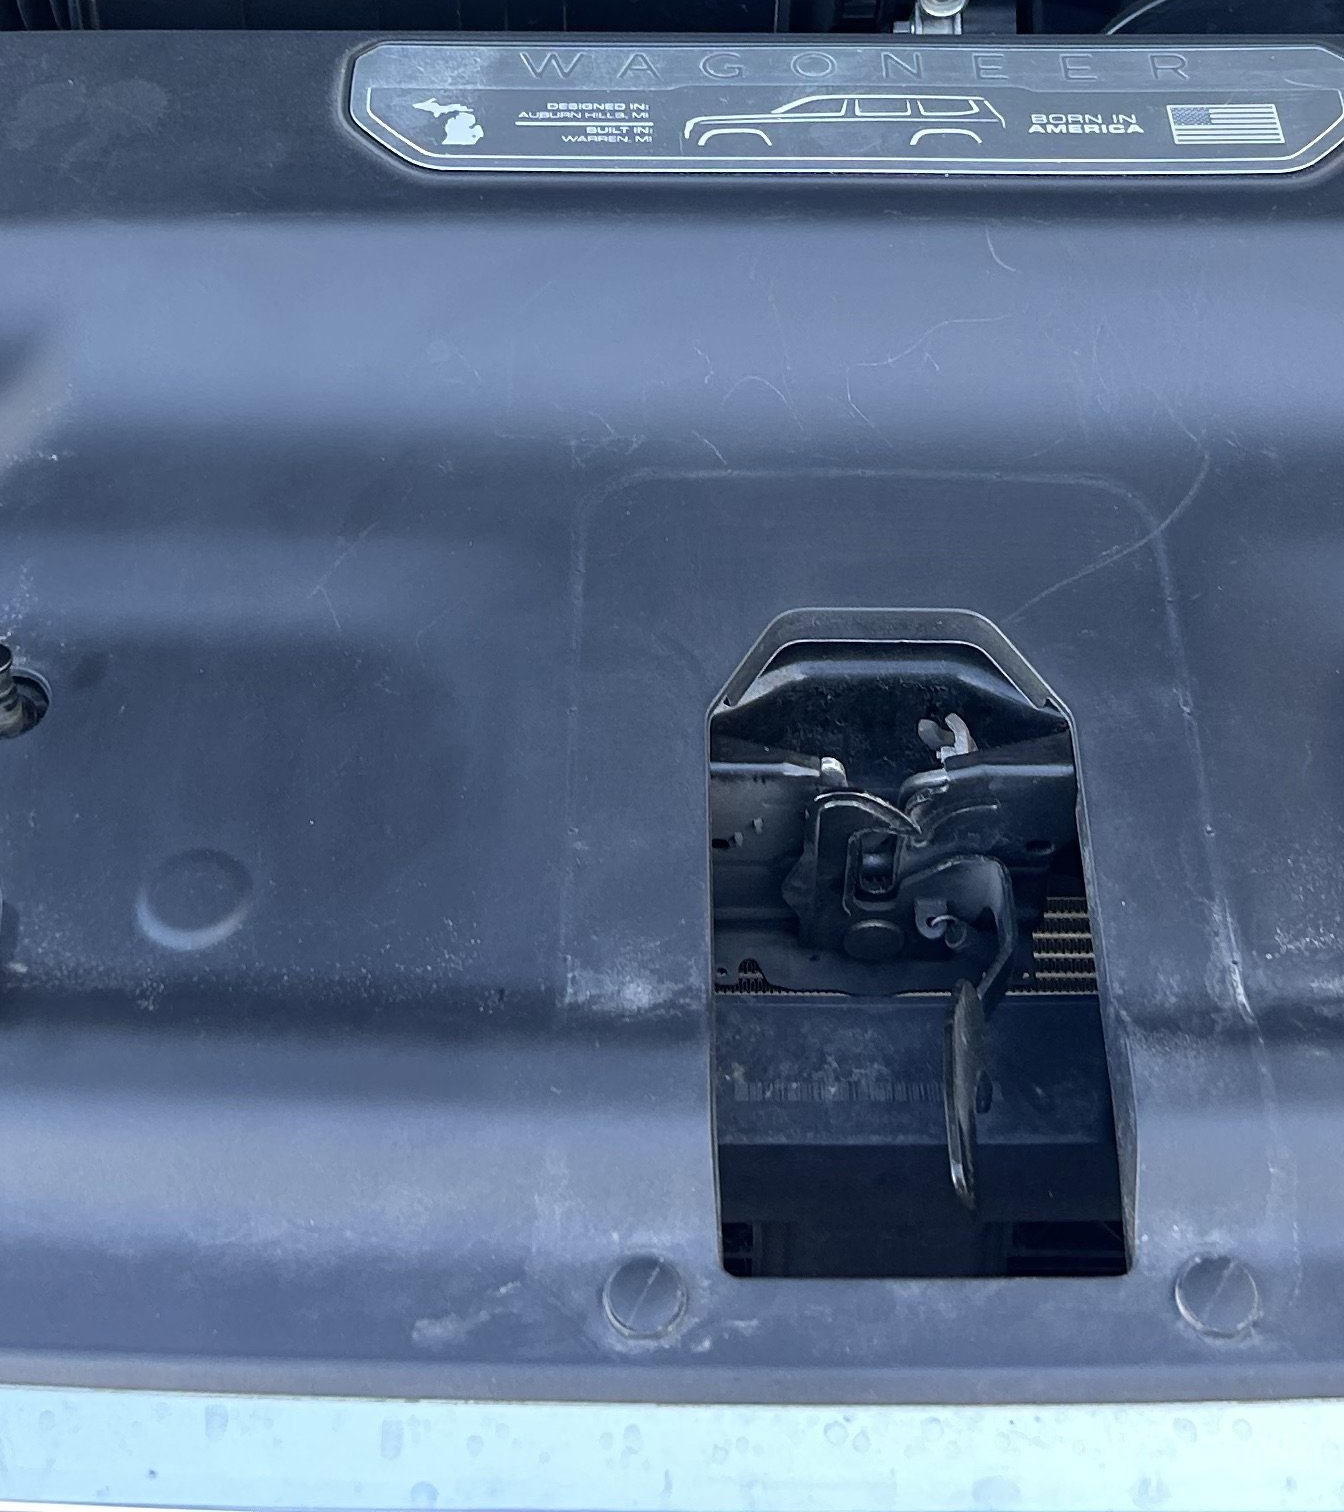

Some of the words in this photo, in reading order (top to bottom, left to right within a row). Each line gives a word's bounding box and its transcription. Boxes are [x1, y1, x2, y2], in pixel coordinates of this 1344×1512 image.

[520, 51, 1190, 81] WAGONEER
[546, 102, 626, 110] DESIGNED
[518, 111, 582, 119] AUBURN
[632, 111, 649, 119] MI
[1030, 113, 1103, 124] BORN
[1112, 113, 1137, 124] IN
[586, 126, 630, 134] BUILT
[1028, 124, 1145, 134] AMERICA
[635, 135, 653, 143] MI
